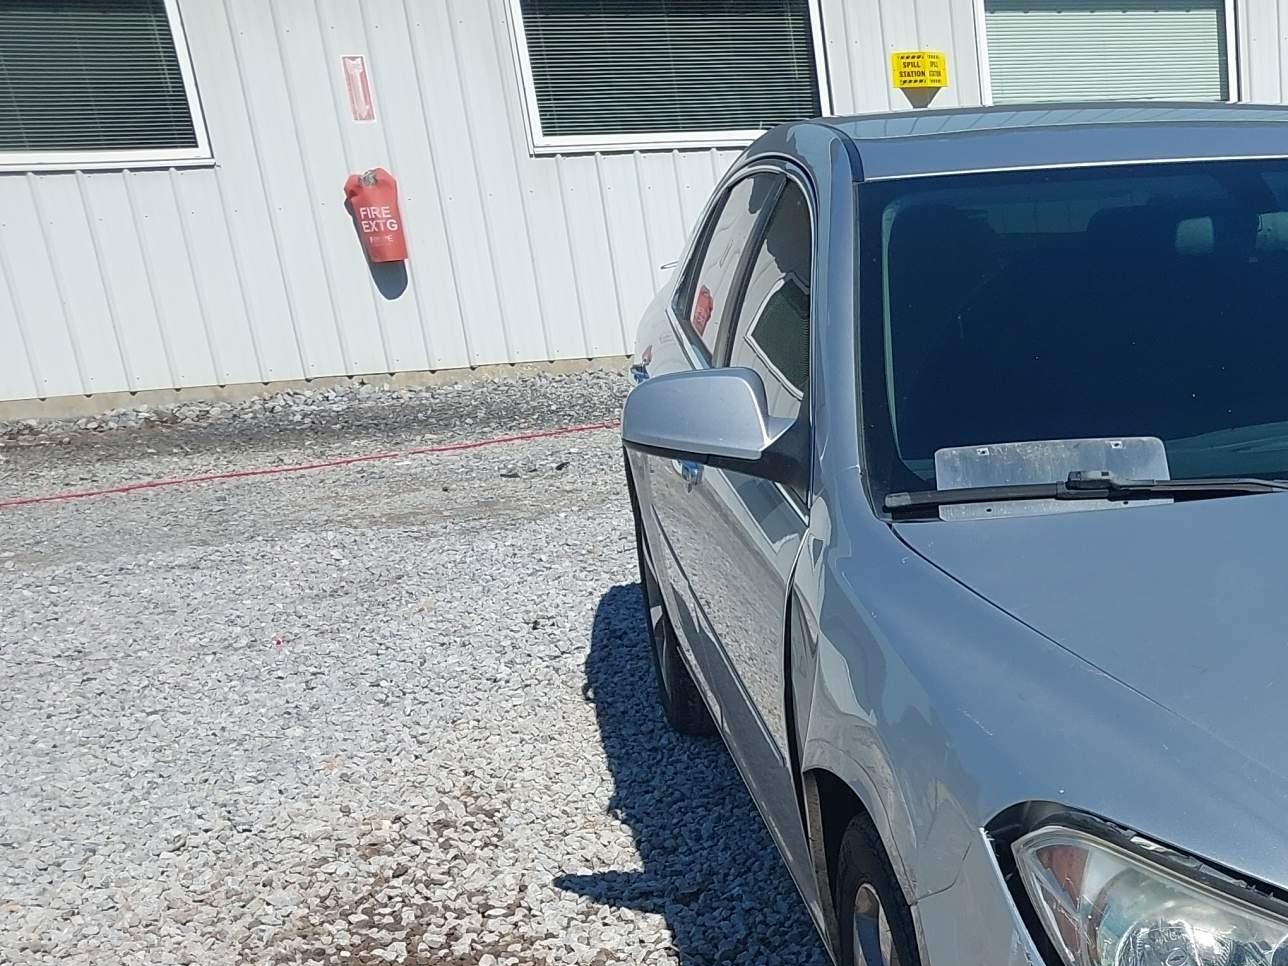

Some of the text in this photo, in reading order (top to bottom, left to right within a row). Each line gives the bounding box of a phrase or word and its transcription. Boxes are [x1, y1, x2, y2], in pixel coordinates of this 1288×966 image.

[902, 61, 921, 69] SPILL
[899, 70, 926, 78] STATION
[359, 206, 392, 219] FIRE
[361, 218, 399, 233] EXTG
